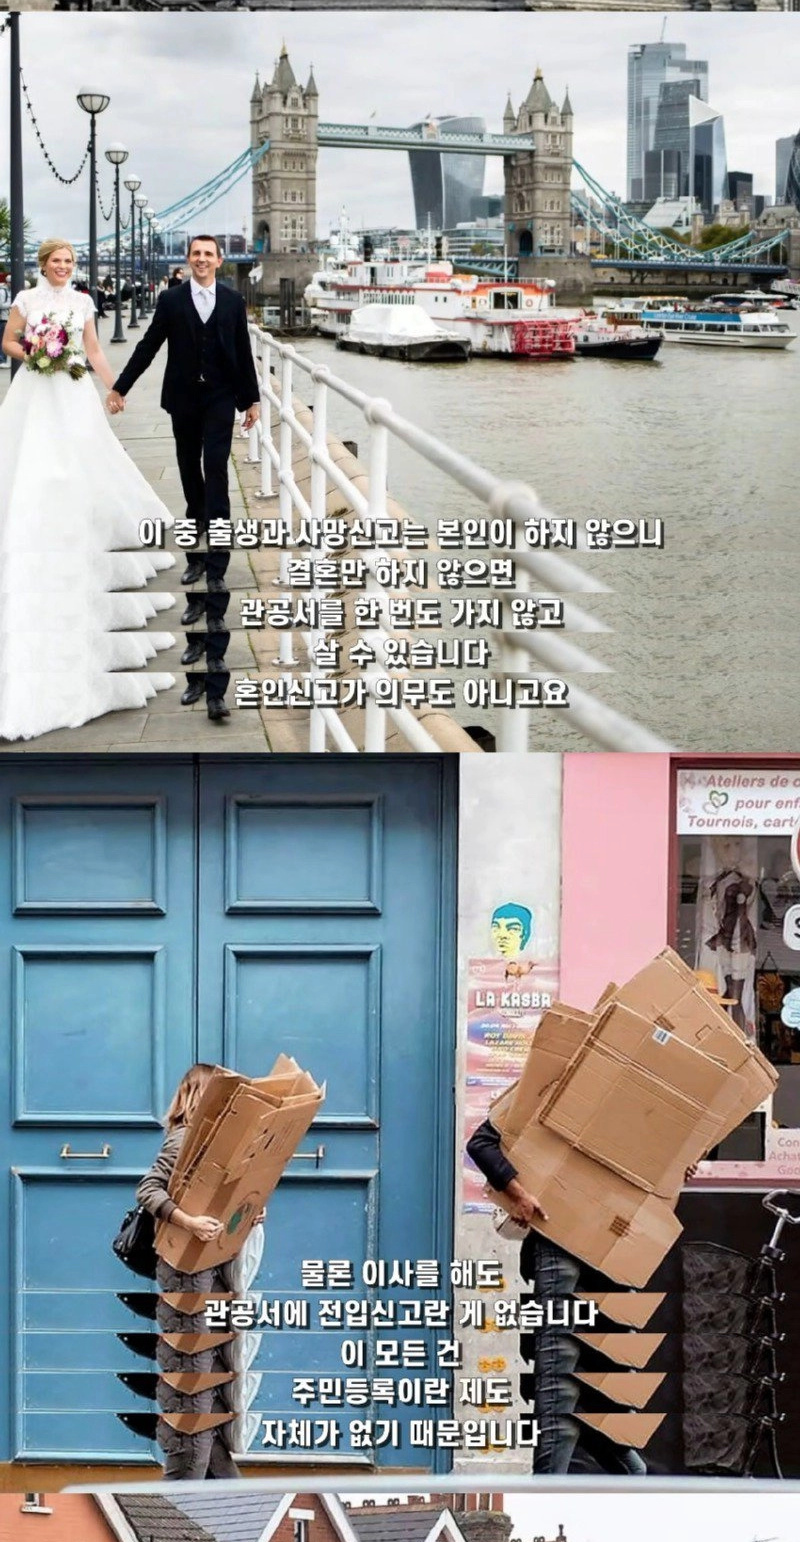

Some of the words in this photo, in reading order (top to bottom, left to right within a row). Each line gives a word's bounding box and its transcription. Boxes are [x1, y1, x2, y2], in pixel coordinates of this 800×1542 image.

[707, 775, 765, 788] Ateliers
[771, 775, 789, 788] de
[735, 799, 771, 811] pour
[688, 815, 758, 829] Tournois,
[475, 991, 496, 1009] LA
[501, 991, 552, 1009] KASBA
